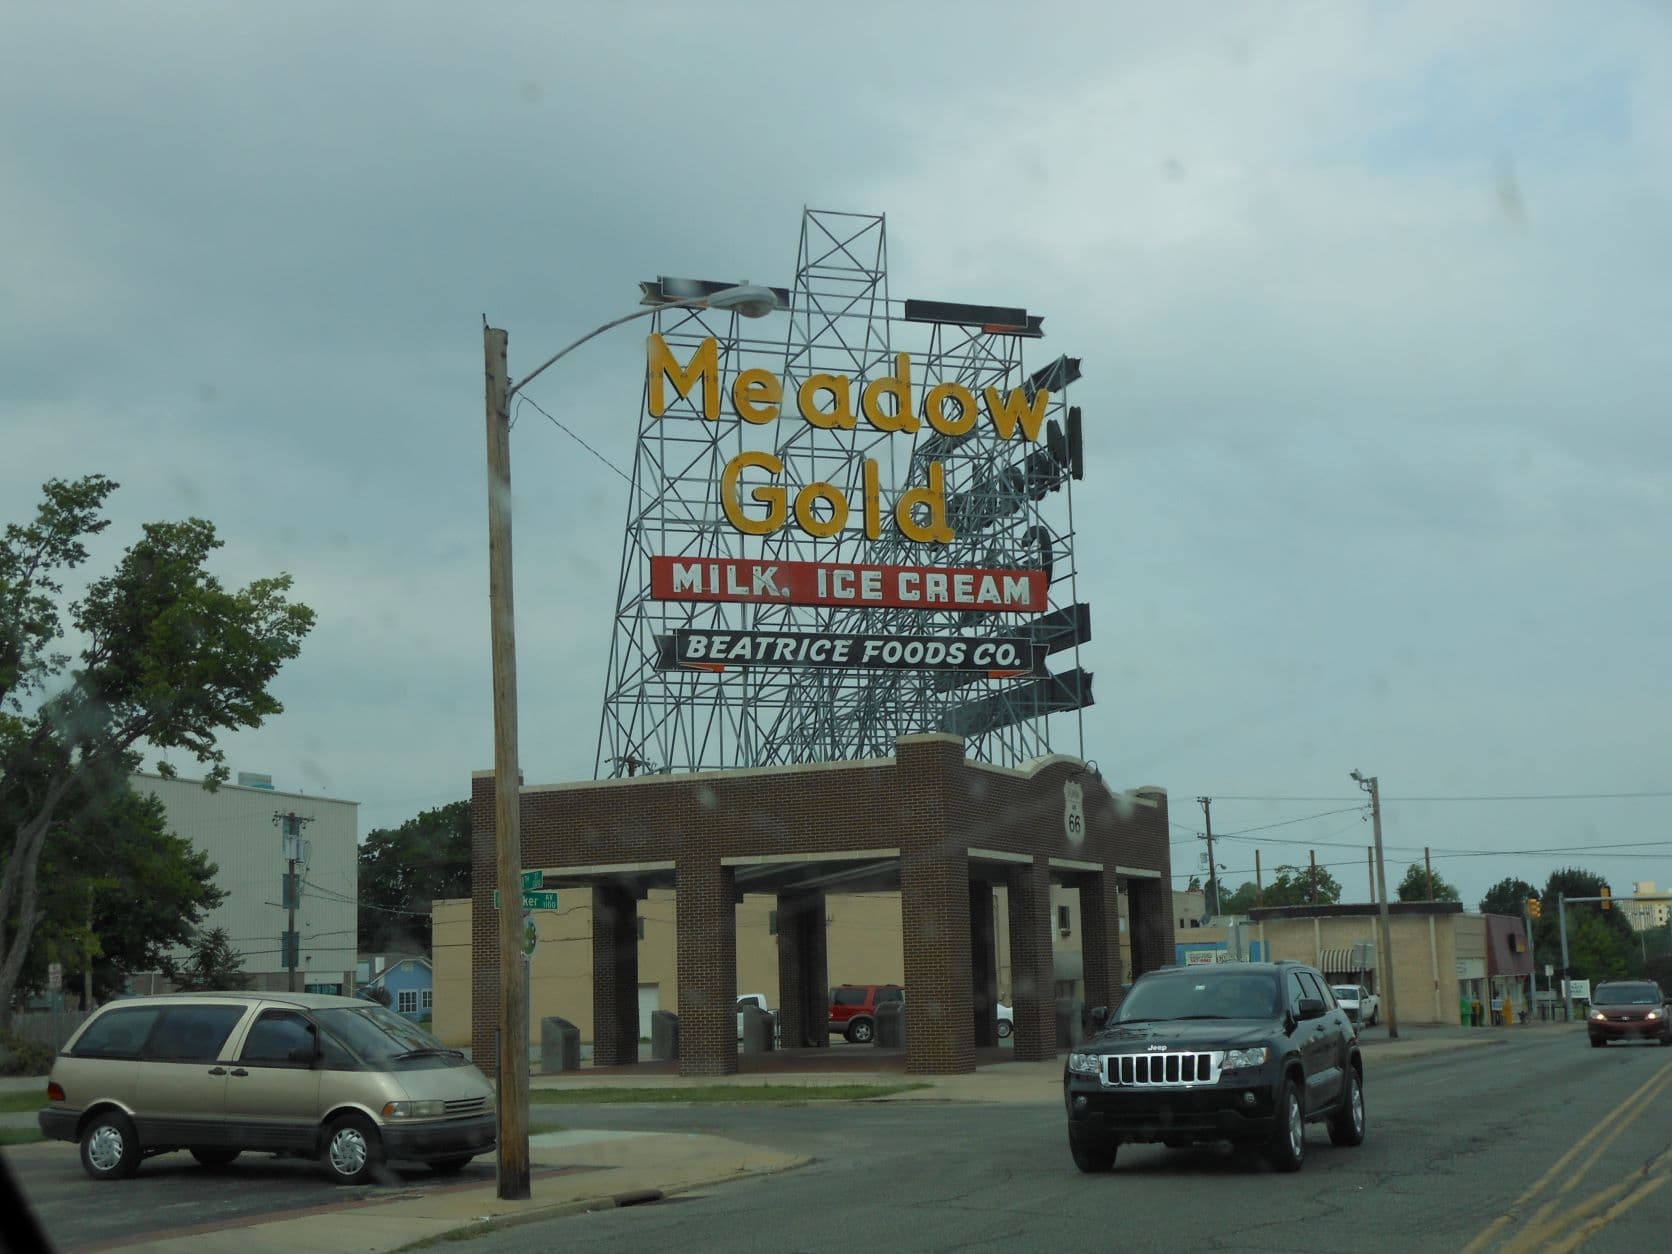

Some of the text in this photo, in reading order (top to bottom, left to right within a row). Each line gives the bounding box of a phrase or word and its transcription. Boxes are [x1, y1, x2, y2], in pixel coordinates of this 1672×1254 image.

[647, 333, 1050, 442] Meadow
[720, 451, 954, 544] Gold
[817, 568, 883, 600] ICE
[898, 572, 1030, 605] CREAM
[686, 635, 1021, 666] BEATRICE FOODS CO.
[1069, 814, 1081, 833] 66
[522, 896, 538, 906] ker
[1147, 1044, 1168, 1052] Jeep
